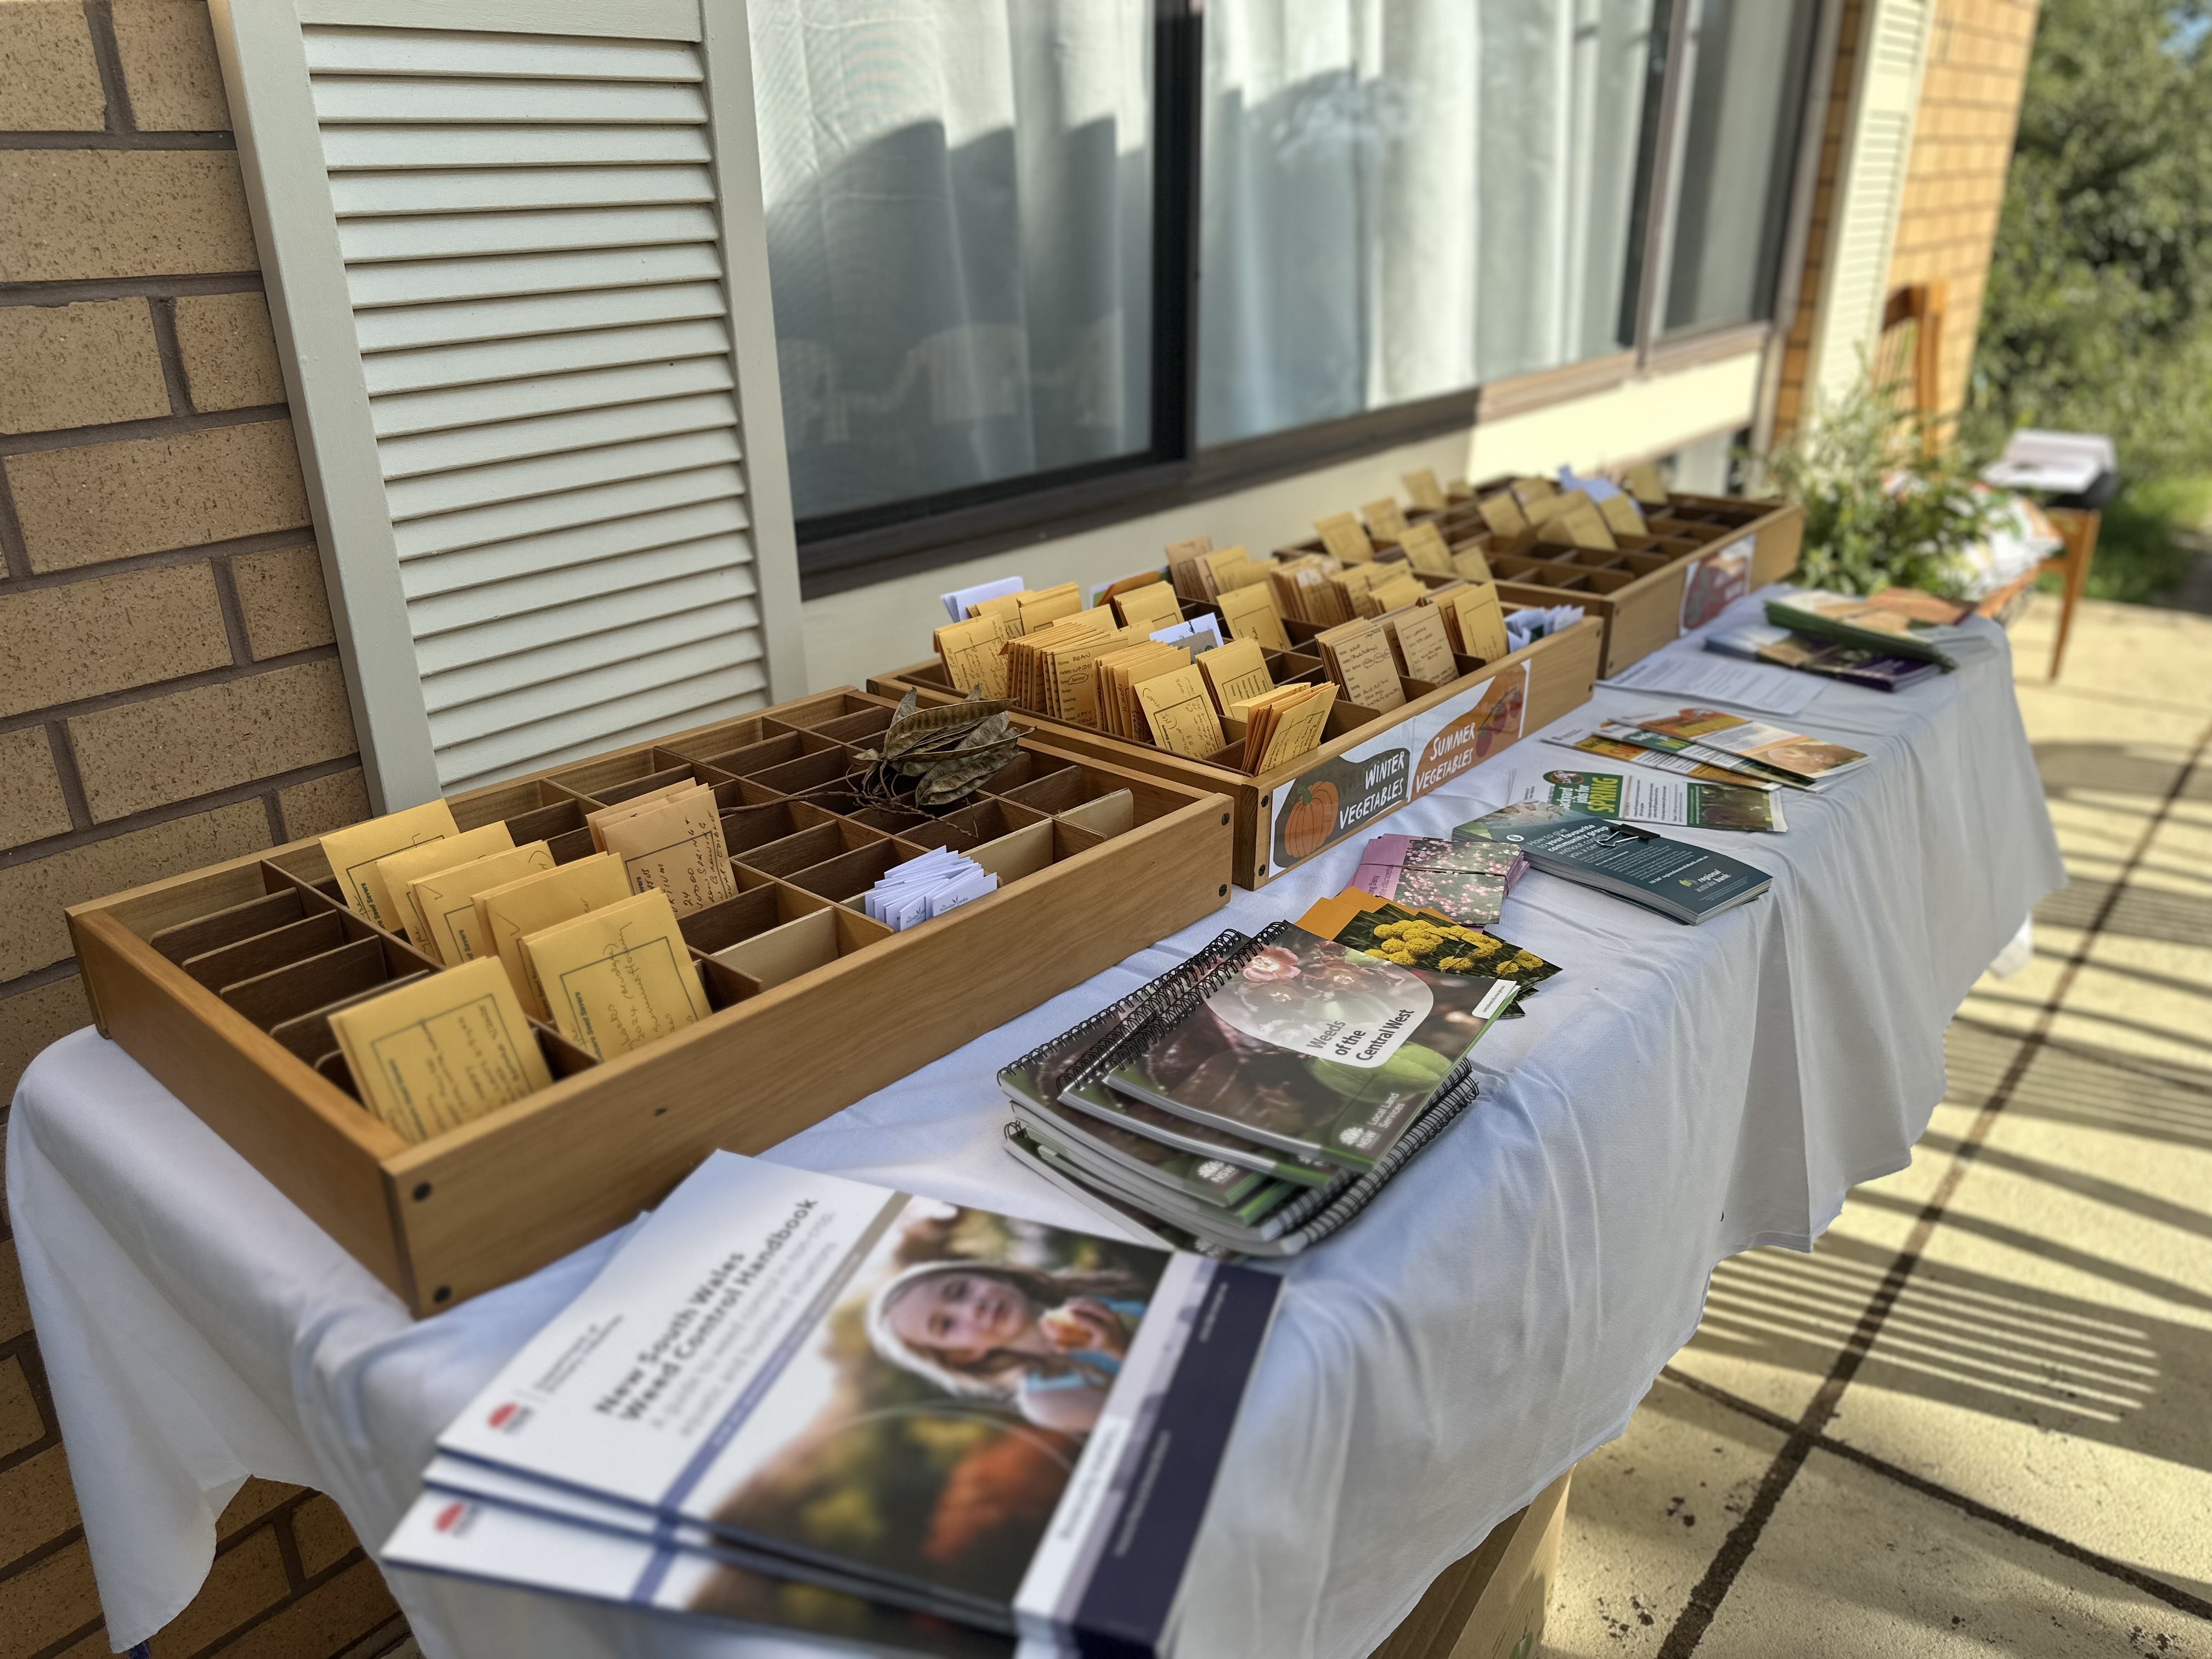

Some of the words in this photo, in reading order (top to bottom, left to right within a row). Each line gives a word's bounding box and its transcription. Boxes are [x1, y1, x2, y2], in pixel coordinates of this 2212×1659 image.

[1072, 652, 1091, 662] BEAN
[1430, 721, 1476, 761] SUMMER
[1416, 748, 1474, 793] VEGETABLES
[1340, 777, 1404, 830] VEGETABLES
[1556, 787, 1573, 810] ackyard
[1587, 777, 1618, 813] SPRING
[1526, 837, 1545, 846] How
[1552, 828, 1568, 837] give
[1545, 836, 1565, 847] your
[1560, 823, 1596, 839] favourite
[1548, 834, 1590, 852] community
[1588, 826, 1609, 838] group
[1556, 842, 1585, 855] without
[1567, 850, 1583, 859] you
[1697, 868, 1722, 883] regional
[1714, 873, 1731, 883] bank
[359, 881, 374, 904] Savers
[369, 903, 381, 920] Seed
[459, 929, 471, 952] Savers
[573, 990, 589, 1017] Savers
[626, 1003, 648, 1041] 2024
[1306, 1020, 1346, 1049] Weeds
[1341, 1030, 1366, 1046] the
[1356, 1029, 1396, 1060] Central
[1382, 1009, 1415, 1030] West
[1335, 1043, 1352, 1056] of
[1366, 1108, 1387, 1125] Local
[1380, 1092, 1400, 1109] Land
[1378, 1103, 1405, 1128] Services
[1356, 1130, 1377, 1149] NSW
[1210, 1165, 1235, 1183] NSW
[617, 1361, 682, 1420] Weed
[672, 1287, 743, 1361] Control
[733, 1198, 820, 1286] Handbook
[593, 1367, 644, 1414] New
[635, 1307, 699, 1365] South
[687, 1251, 746, 1305] Wales
